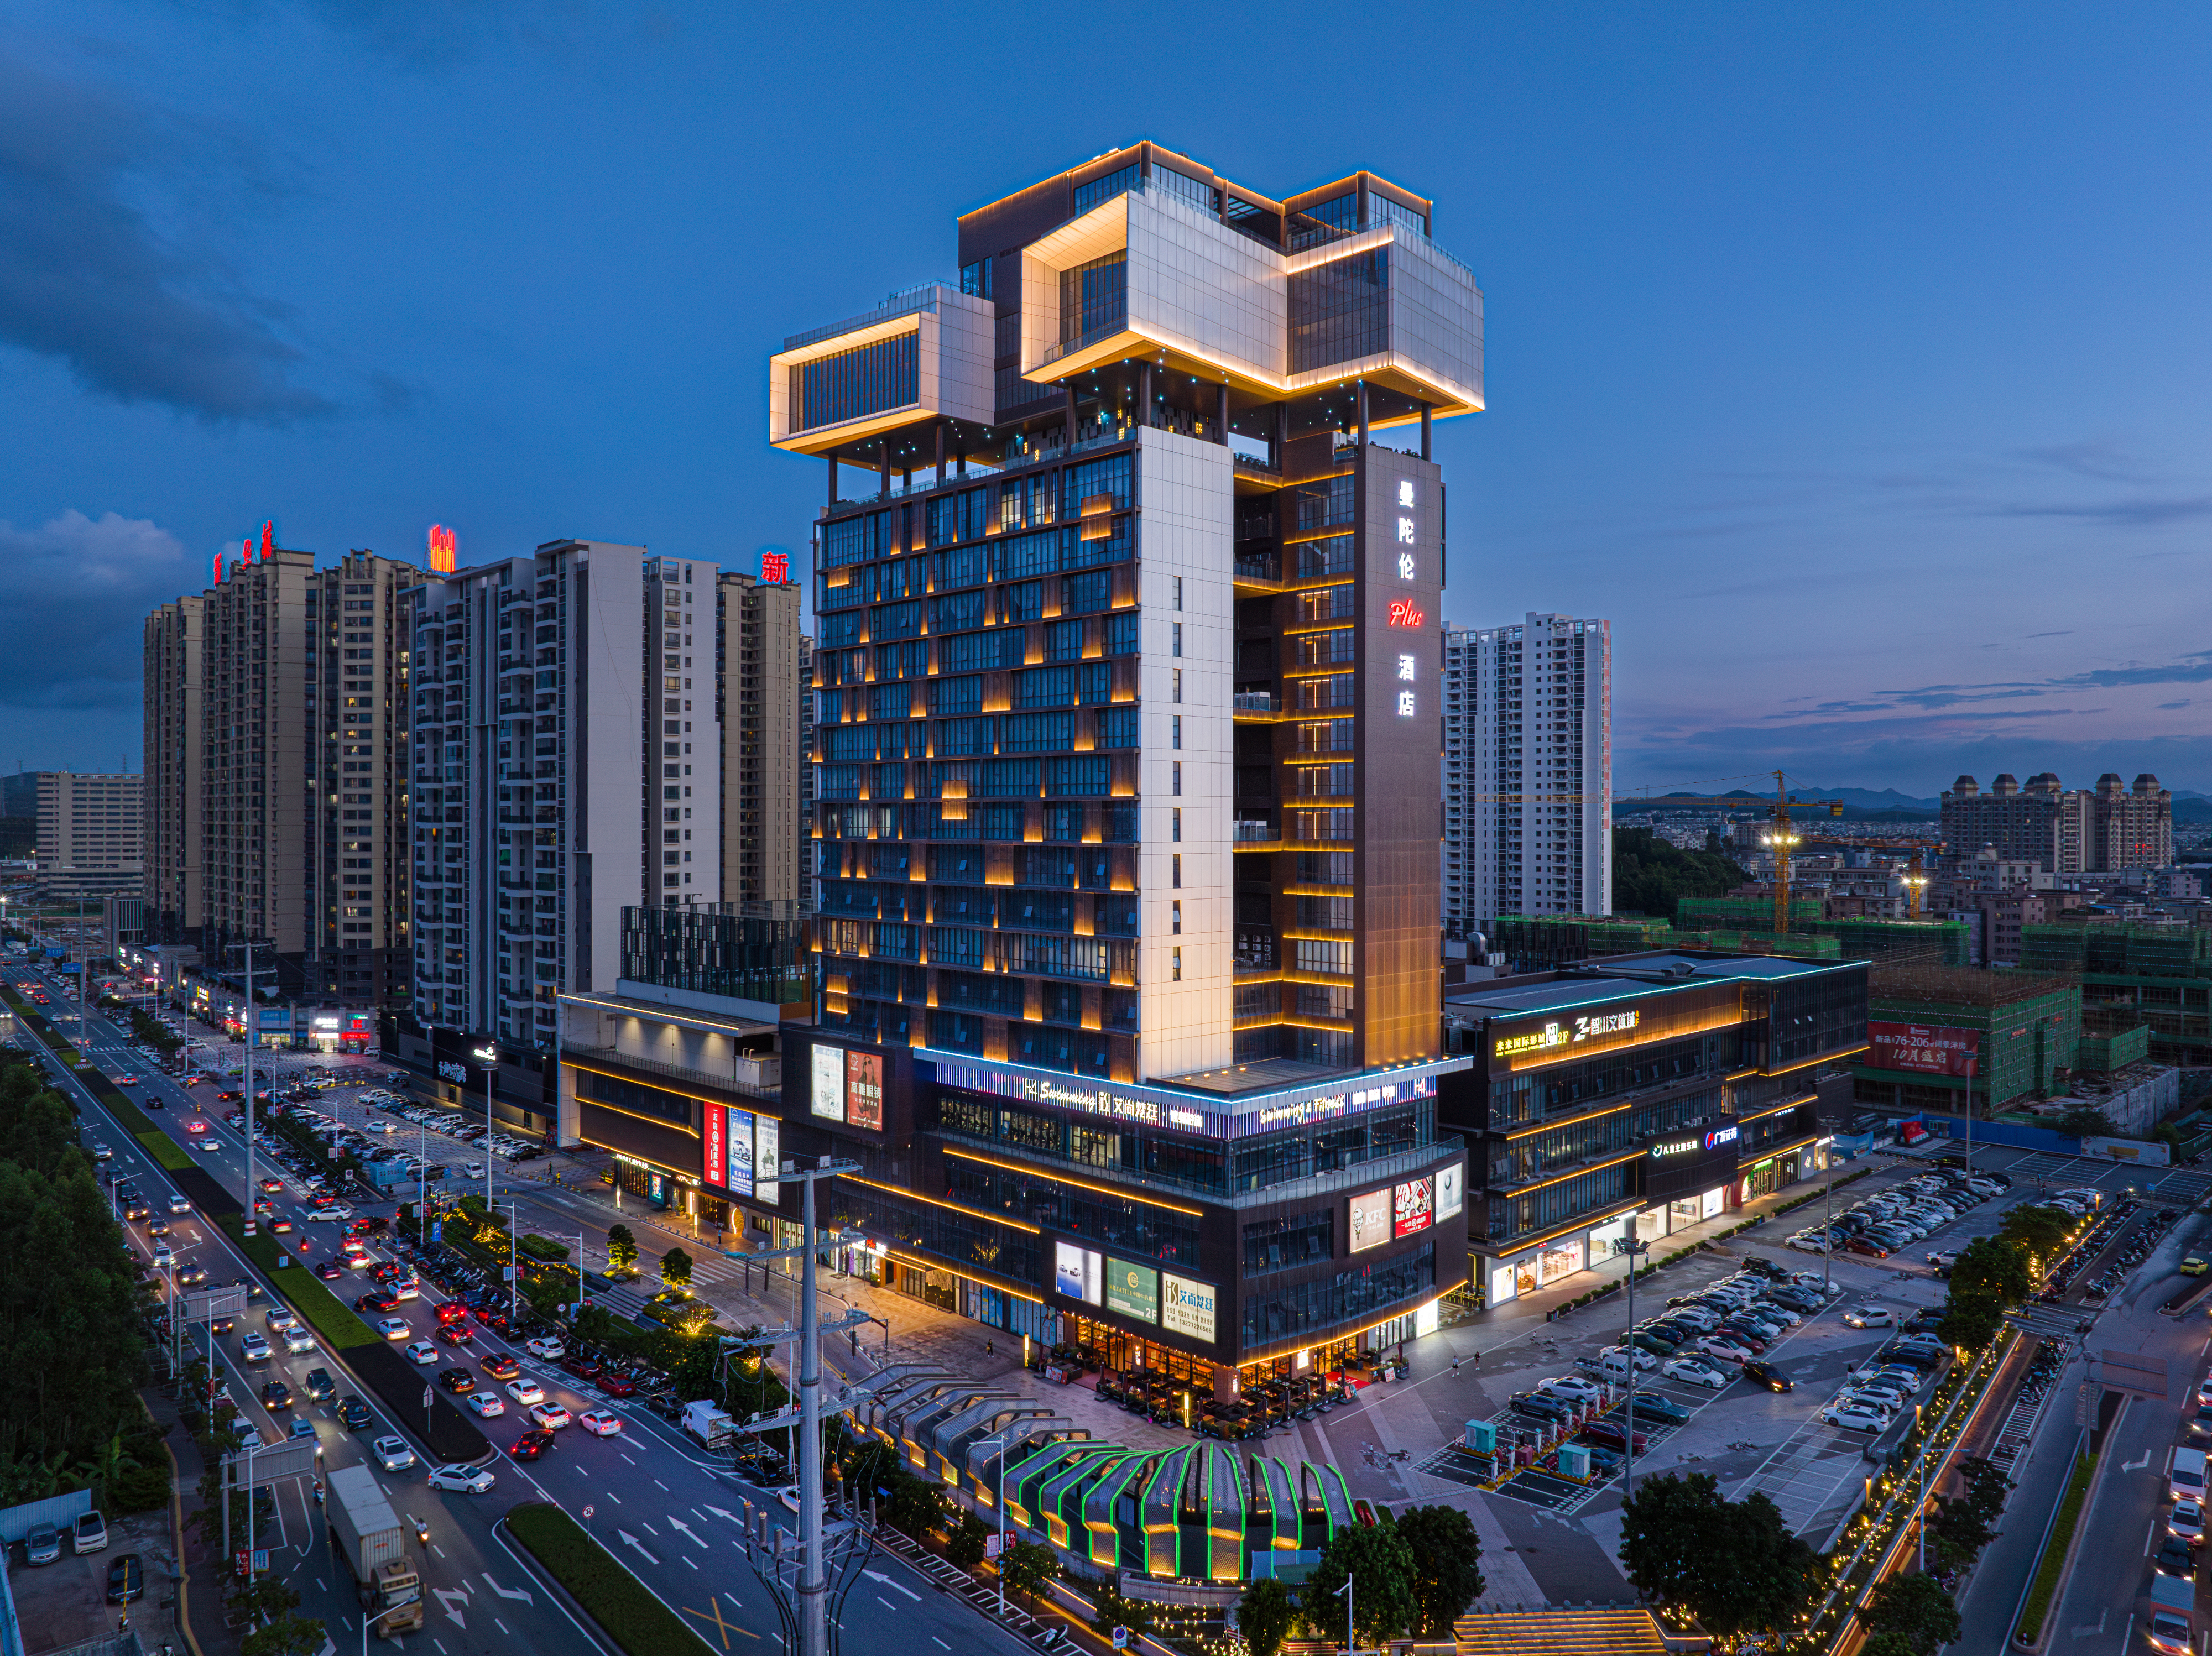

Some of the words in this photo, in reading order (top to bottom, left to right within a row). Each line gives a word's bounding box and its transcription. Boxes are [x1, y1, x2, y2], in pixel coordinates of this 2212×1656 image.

[1398, 480, 1414, 579] 曼陀伦
[761, 552, 789, 584] 新
[1390, 599, 1423, 626] Plus
[1398, 654, 1415, 717] 酒店
[1496, 1033, 1546, 1052] 米米国际影城
[1558, 1031, 1569, 1044] 2F
[1875, 1035, 1891, 1043] 新品
[1895, 1035, 1929, 1048] 76-206
[1893, 1048, 1947, 1064] 10月盛启
[851, 1081, 881, 1099] 高雅眼镜
[1040, 1082, 1096, 1111] Swimming
[1260, 1103, 1304, 1124] Swimming
[1313, 1094, 1345, 1112] Fitness
[1714, 1127, 1738, 1145] 广发证券
[1365, 1208, 1386, 1226] KFC
[1145, 1307, 1157, 1319] 2F
[1167, 1314, 1177, 1323] Tel:
[1180, 1318, 1212, 1334] 13277226565
